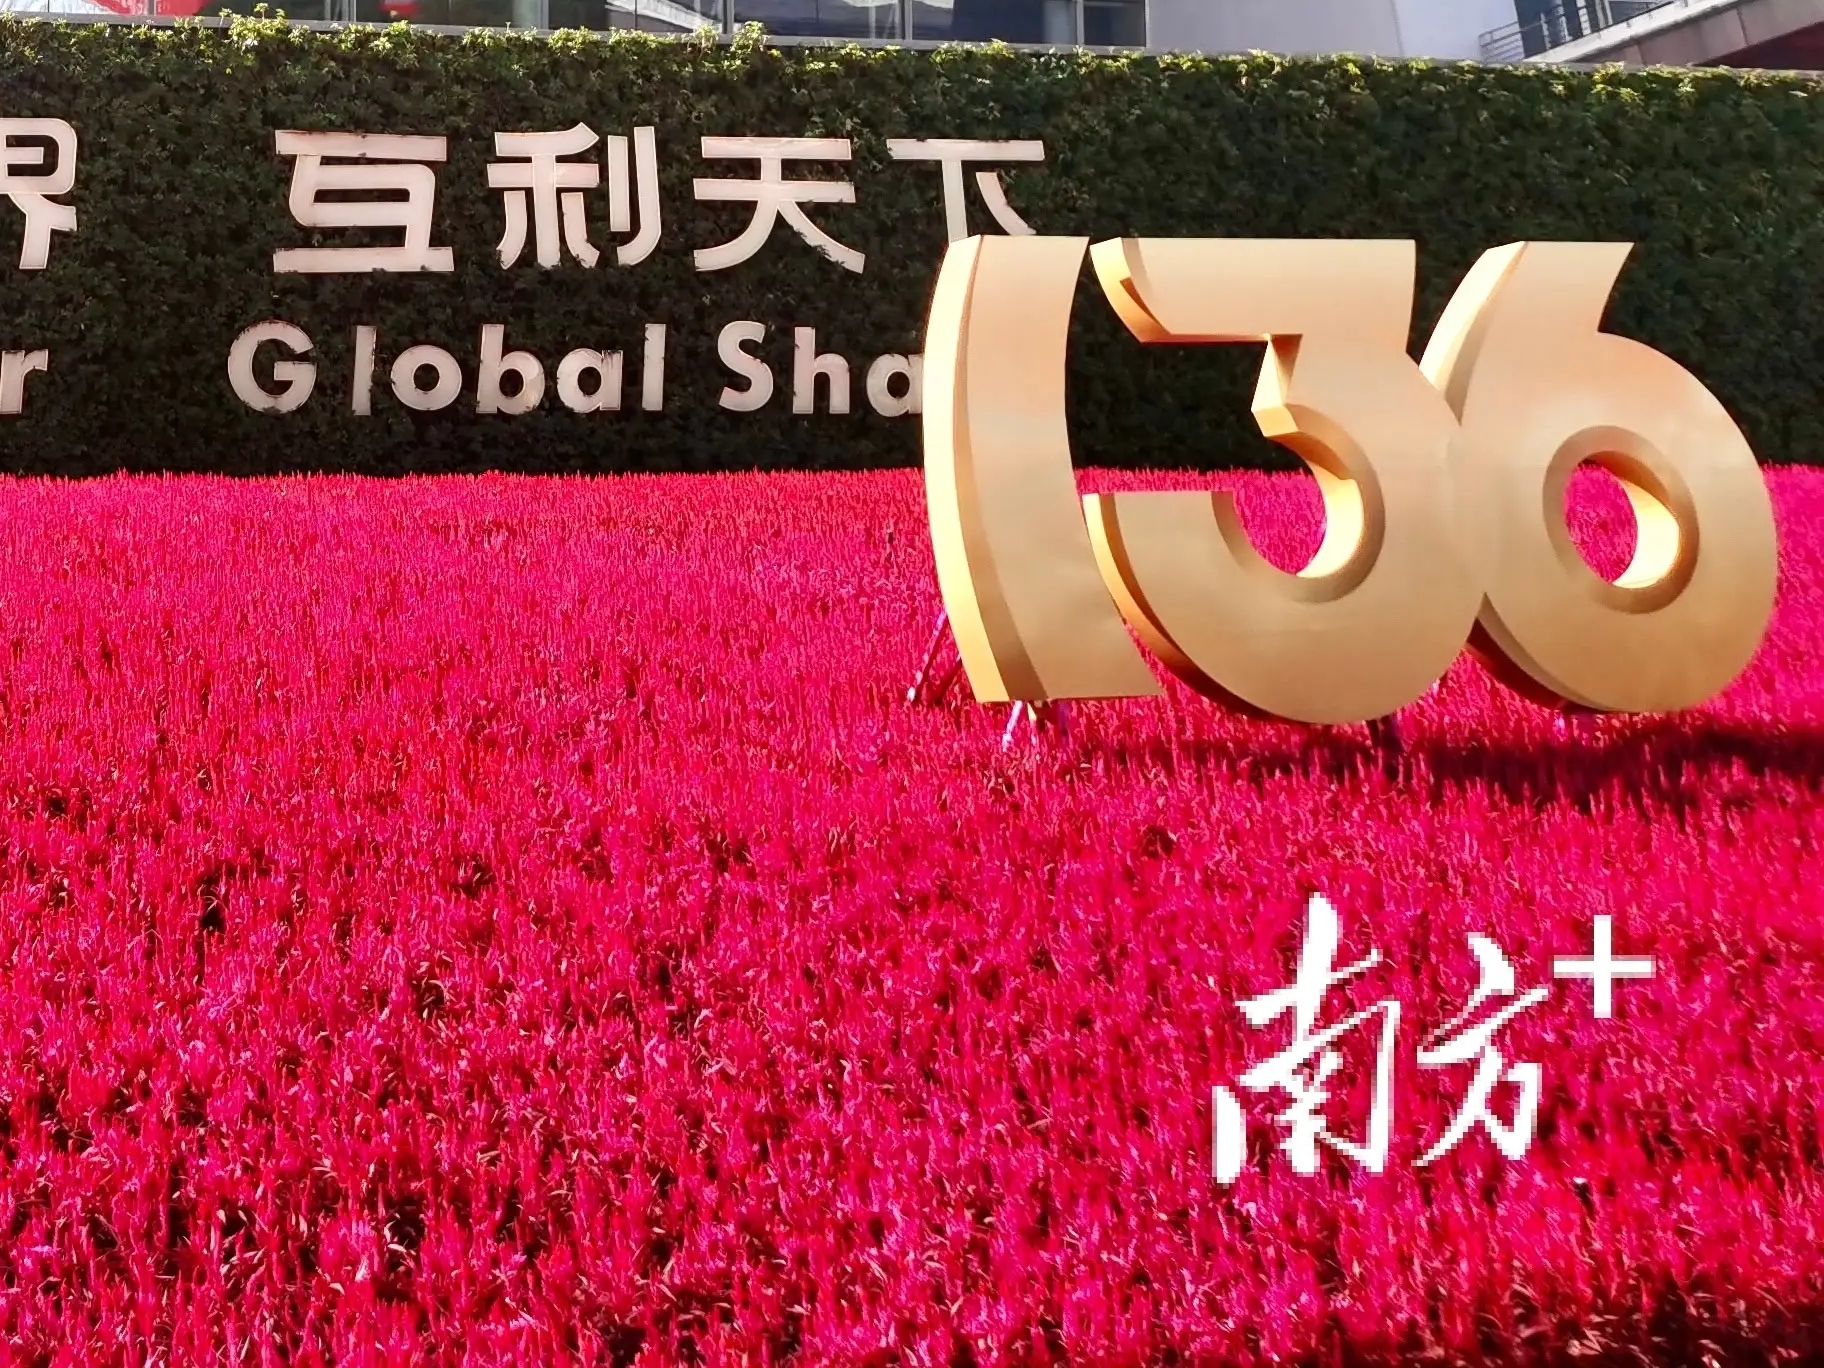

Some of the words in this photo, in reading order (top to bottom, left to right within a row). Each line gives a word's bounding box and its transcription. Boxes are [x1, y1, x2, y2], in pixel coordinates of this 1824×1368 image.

[272, 121, 1046, 273] 互利天下
[227, 319, 668, 416] Global
[922, 235, 1779, 725] 136
